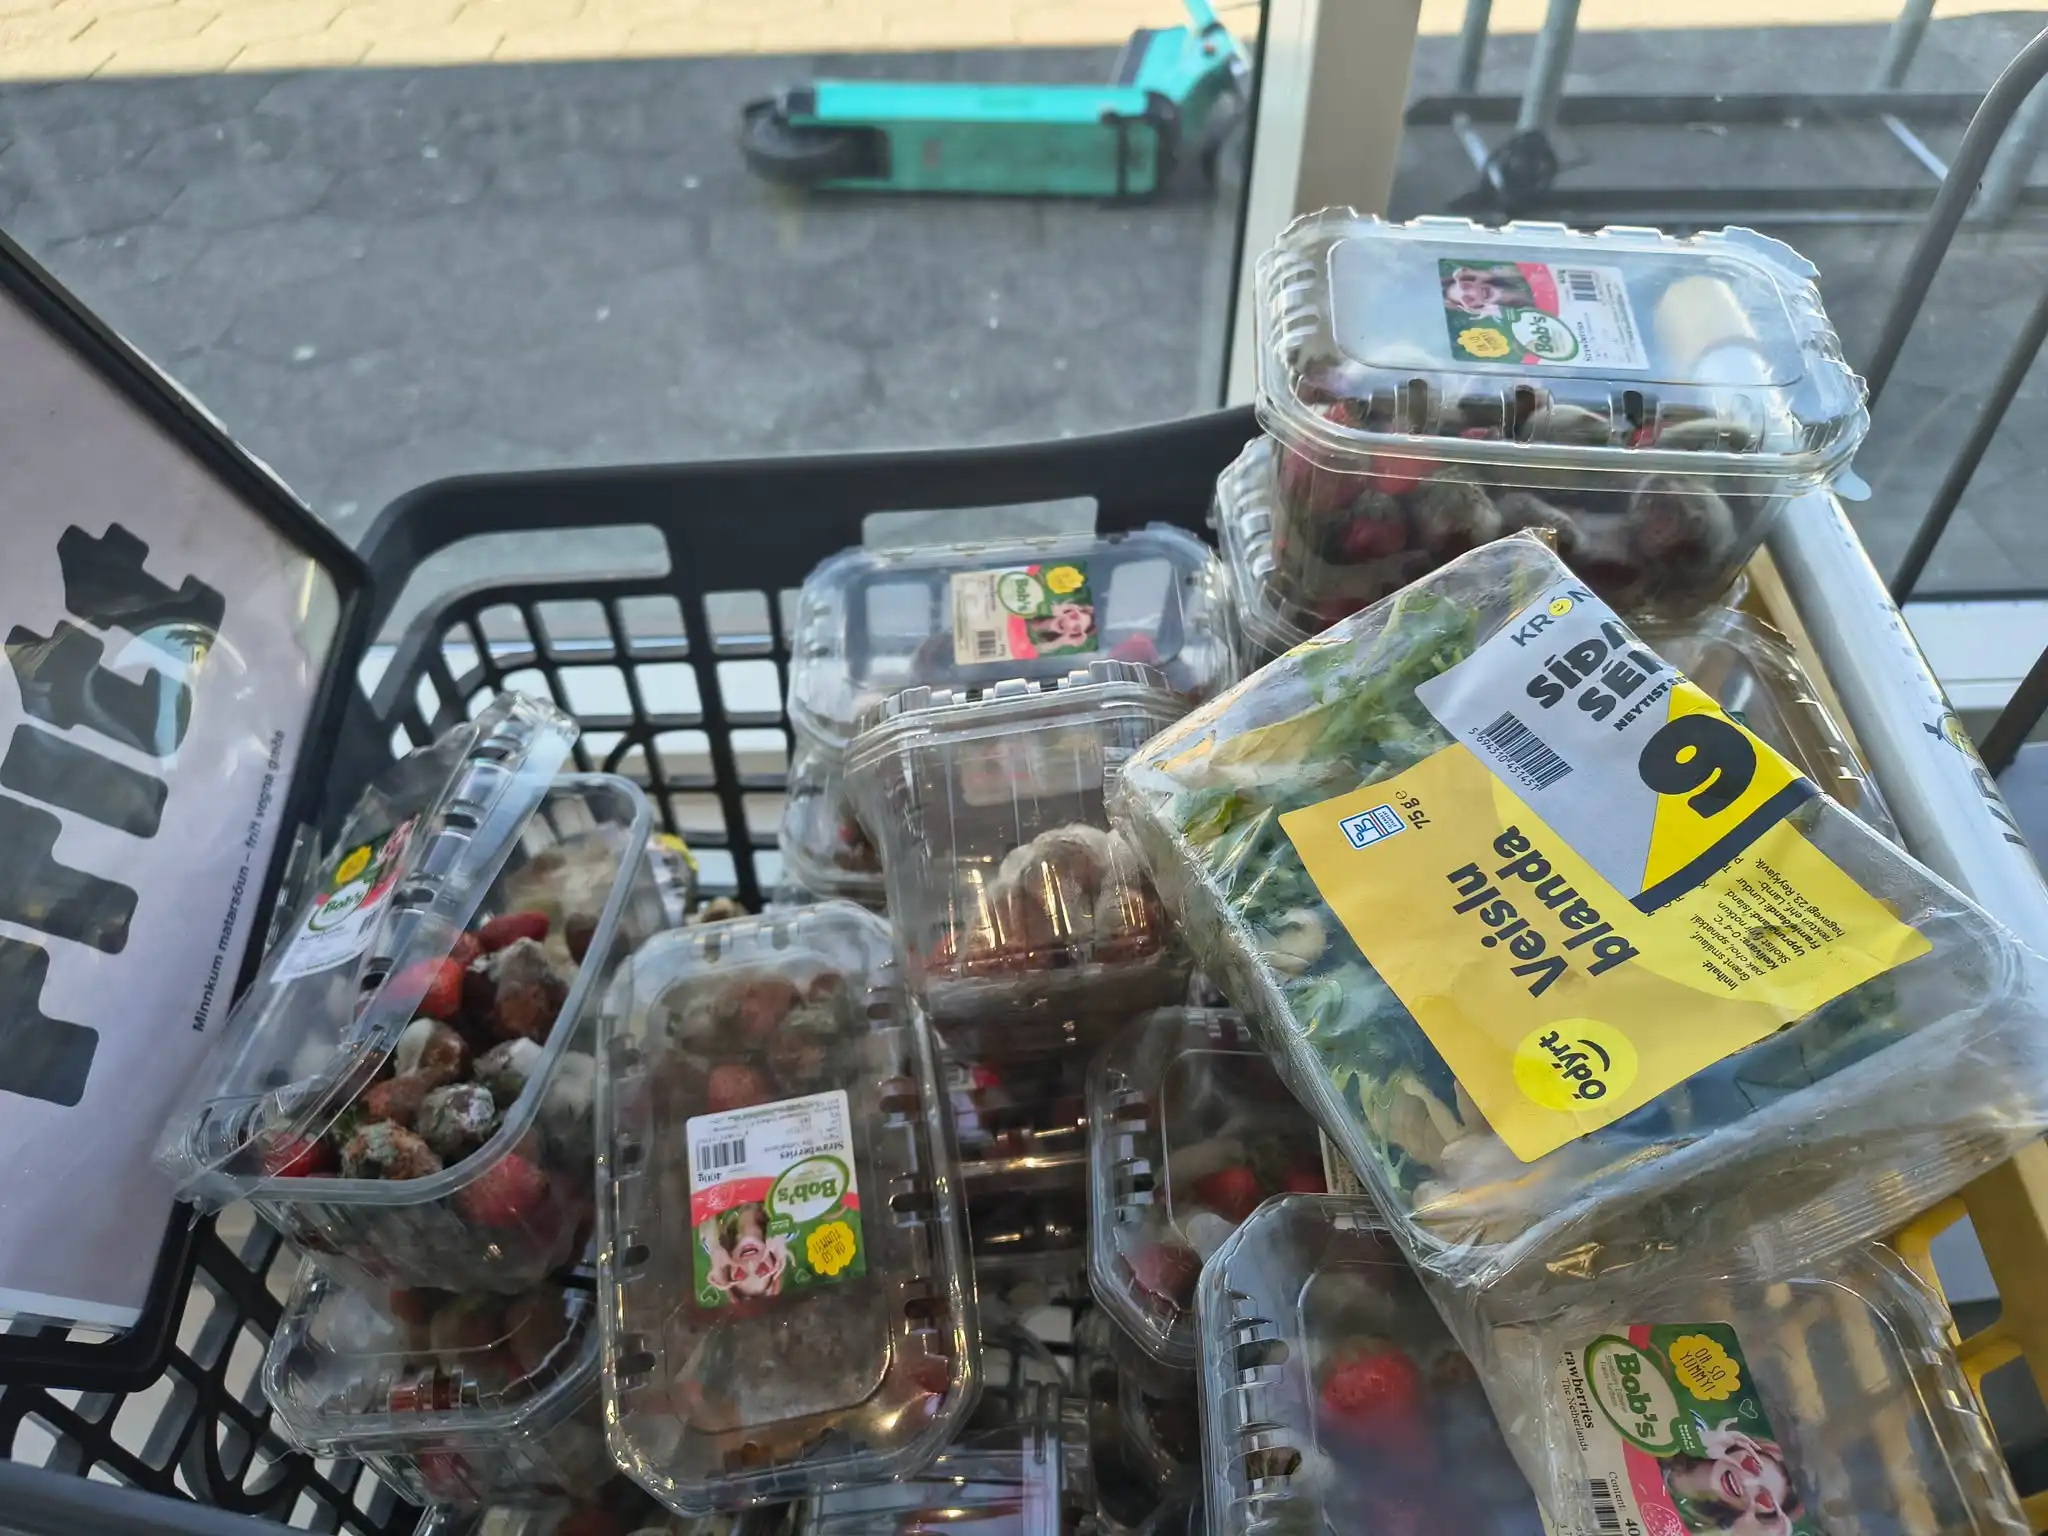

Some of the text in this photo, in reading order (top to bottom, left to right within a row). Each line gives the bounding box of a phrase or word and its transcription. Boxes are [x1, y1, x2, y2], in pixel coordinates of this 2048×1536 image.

[1530, 316, 1554, 353] Bob's
[1015, 578, 1029, 611] Bob's
[1613, 682, 1673, 731] NEYTIST
[1734, 876, 1766, 905] Lundur
[1754, 858, 1795, 896] Reykjavík
[1757, 881, 1785, 904] Lamb-
[1490, 825, 1640, 976] blanda
[1446, 861, 1567, 998] Veislu
[1716, 900, 1790, 963] Skolist fyrir notkun.
[1724, 888, 1805, 955] Upprunaland: Ísland.
[1762, 902, 1821, 949] Framleiðandi:
[1801, 917, 1833, 942] ræktun
[1805, 904, 1845, 936] hagavegi
[192, 953, 224, 1031] Minnkum
[216, 865, 250, 951] matarsóun
[1689, 930, 1750, 981] Grænt smálauf,
[1727, 943, 1748, 962] choi,
[1740, 935, 1778, 970] Kælivara:
[1701, 959, 1738, 990] Innihald:
[1745, 961, 1765, 976] pak
[1538, 1030, 1605, 1099] Ódýrt
[780, 1140, 844, 1160] Strawberries
[777, 1178, 836, 1203] Bob's
[1679, 1351, 1715, 1393] YUMMY!
[1708, 1365, 1725, 1381] SO
[1613, 1352, 1658, 1439] Bob's
[1560, 1379, 1588, 1451] The Netherlands
